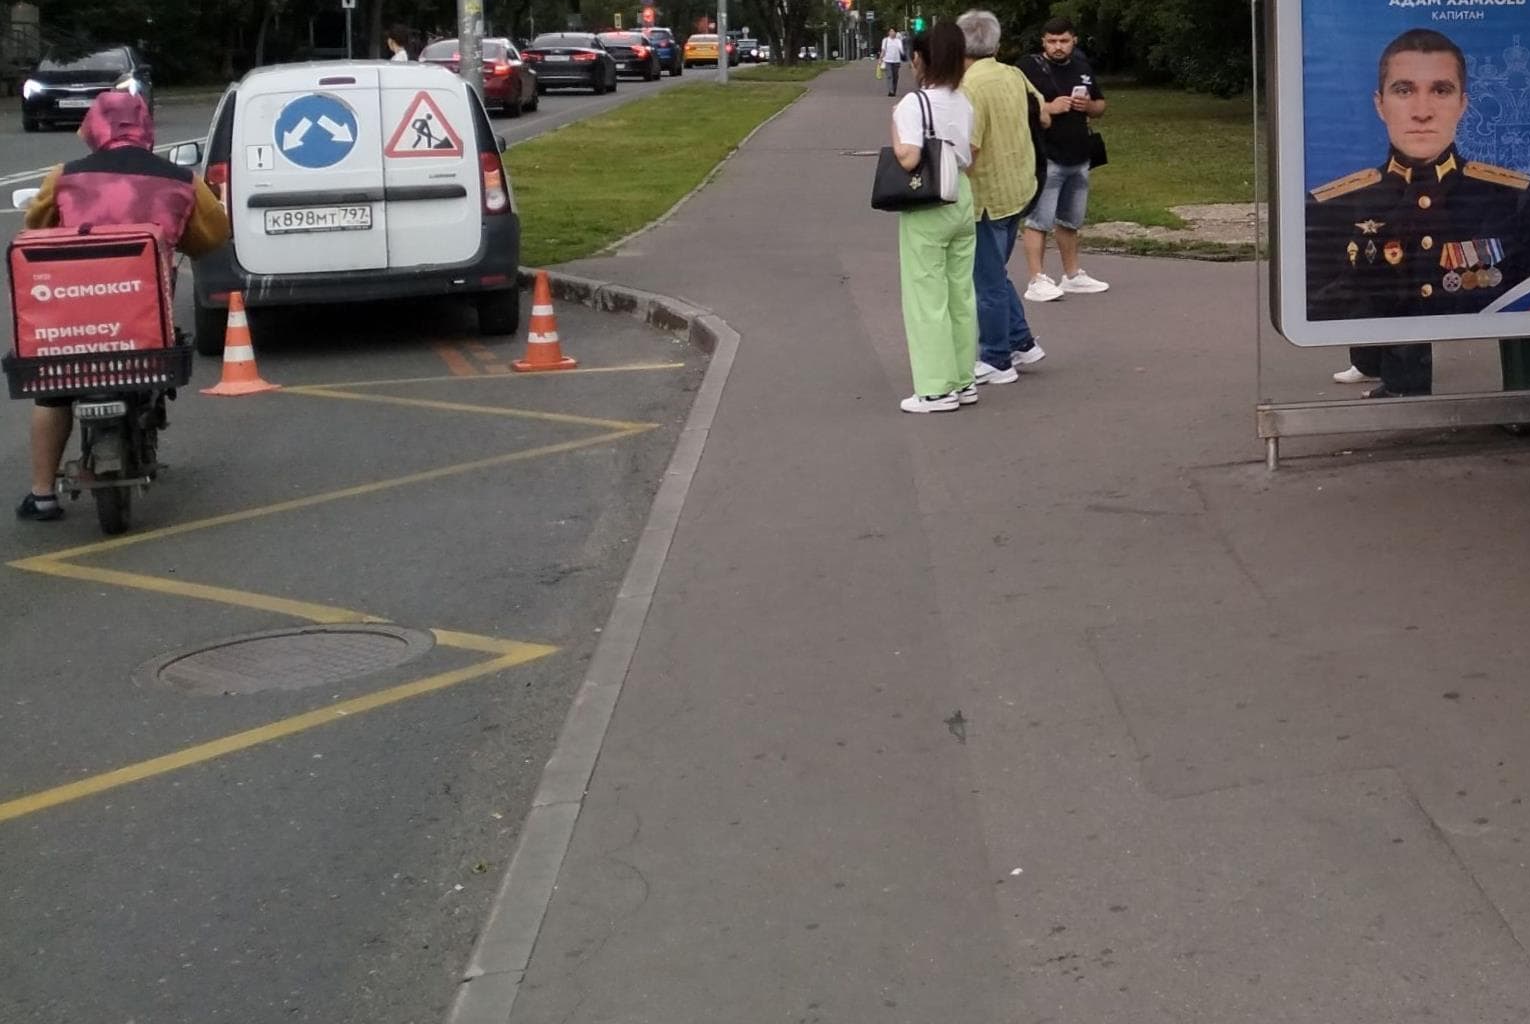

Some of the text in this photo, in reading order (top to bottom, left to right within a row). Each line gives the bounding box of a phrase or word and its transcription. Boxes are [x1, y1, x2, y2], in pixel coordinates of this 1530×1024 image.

[1431, 10, 1484, 21] КАПИТАН
[340, 207, 366, 220] 797
[54, 279, 142, 299] самокат
[35, 322, 120, 342] принесу
[37, 339, 136, 357] продукты
